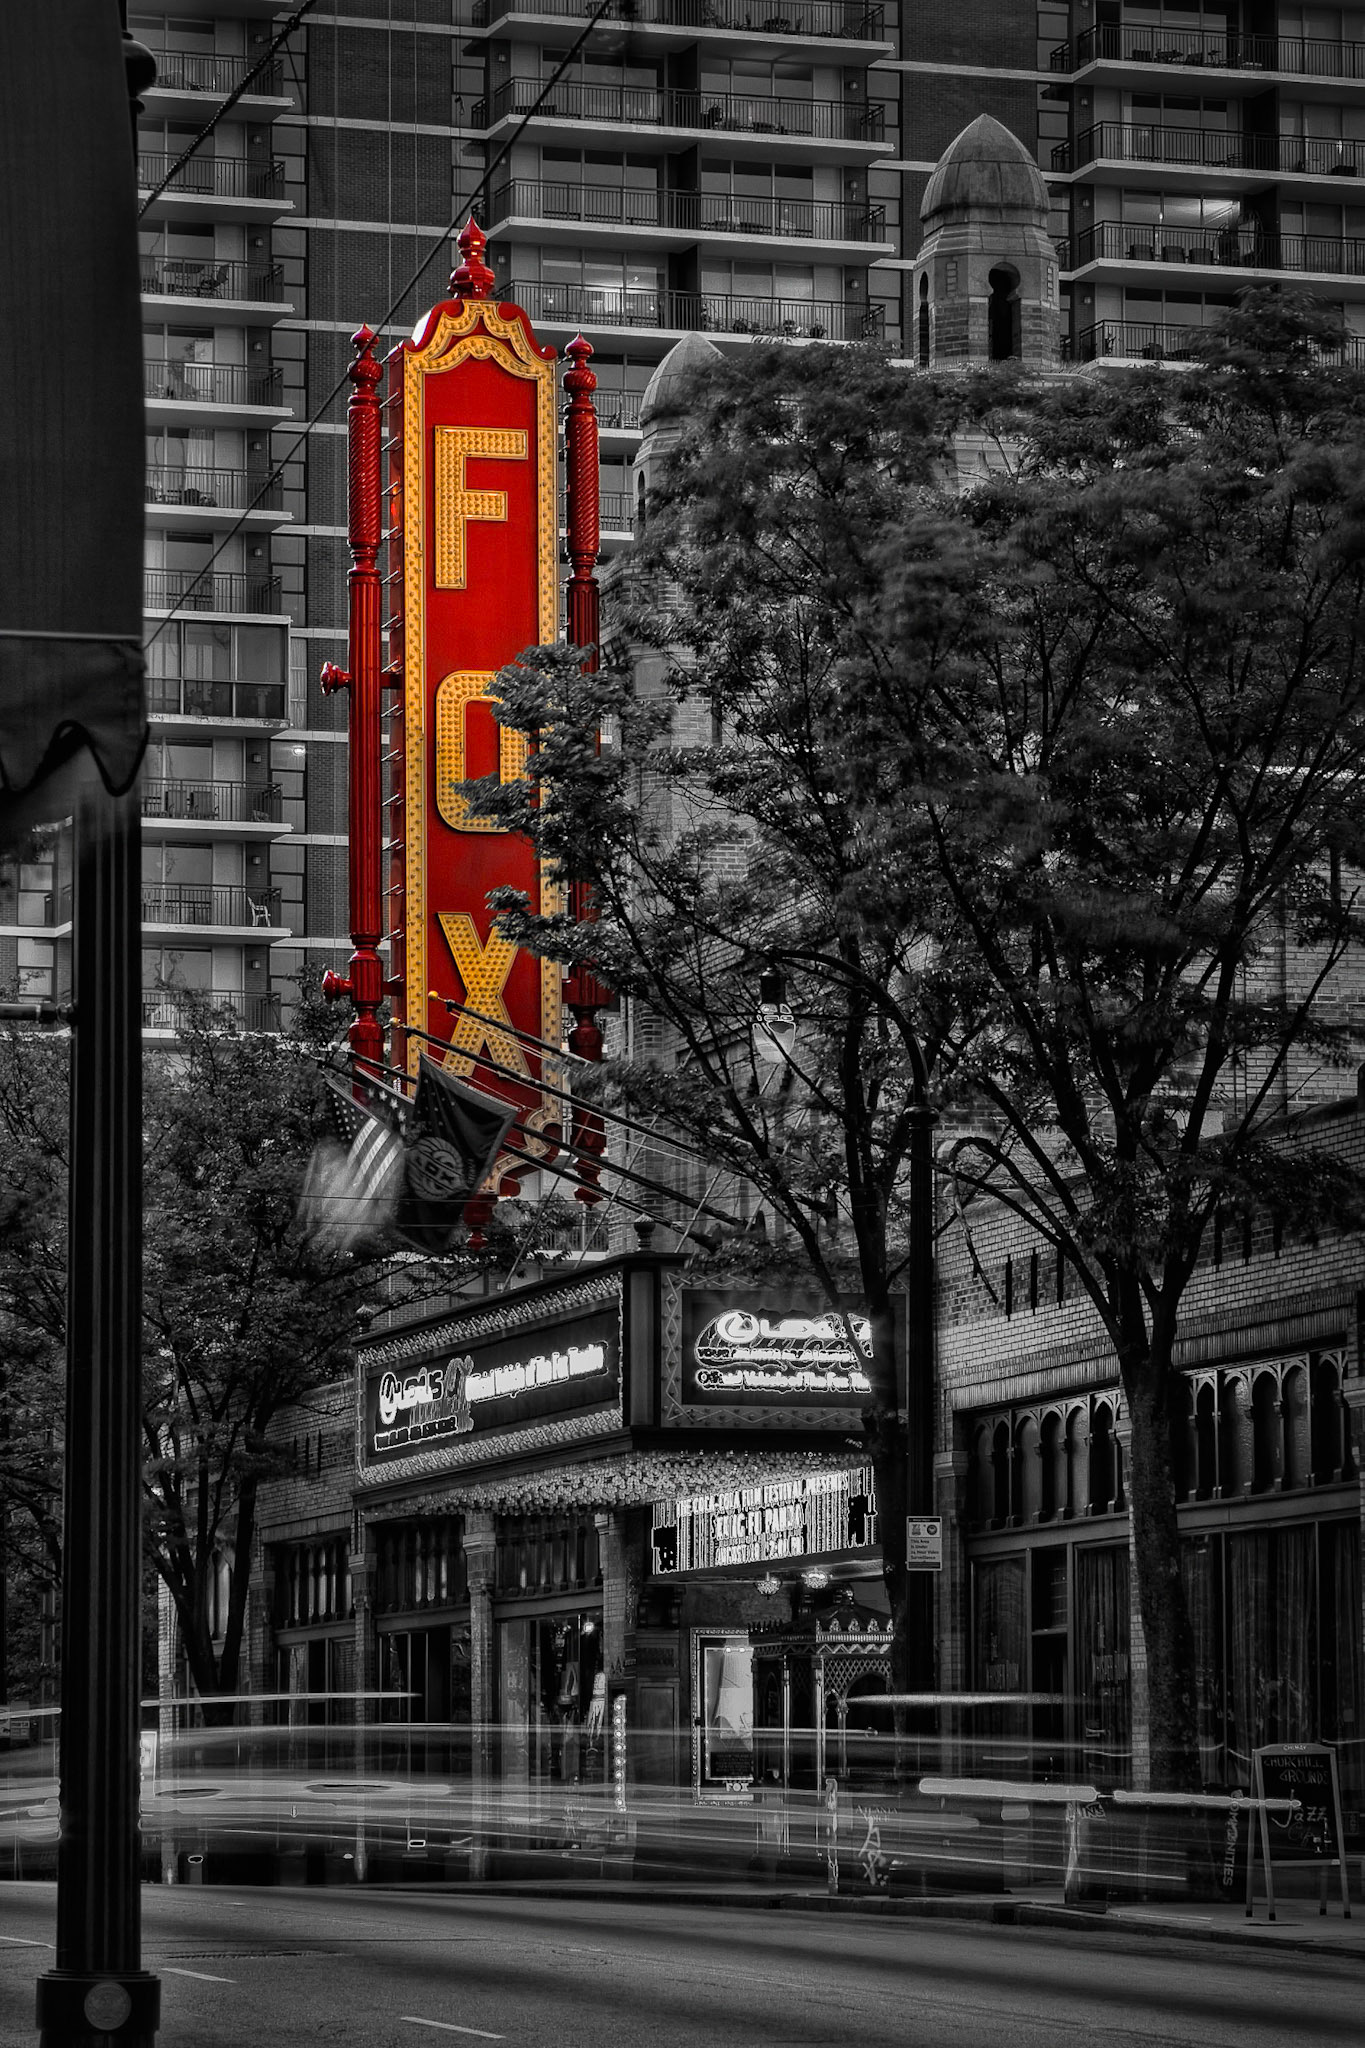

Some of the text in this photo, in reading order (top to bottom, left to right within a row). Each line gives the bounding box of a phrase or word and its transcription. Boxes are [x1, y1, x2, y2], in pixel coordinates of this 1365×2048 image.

[434, 425, 529, 1079] FOX
[416, 1157, 455, 1184] FOX
[677, 1499, 692, 1517] THE
[742, 1486, 762, 1508] FILM
[763, 1479, 803, 1504] FESTIVAL
[806, 1472, 849, 1495] PRESENTS
[747, 1508, 762, 1535] FU
[725, 1781, 749, 1793] FOX
